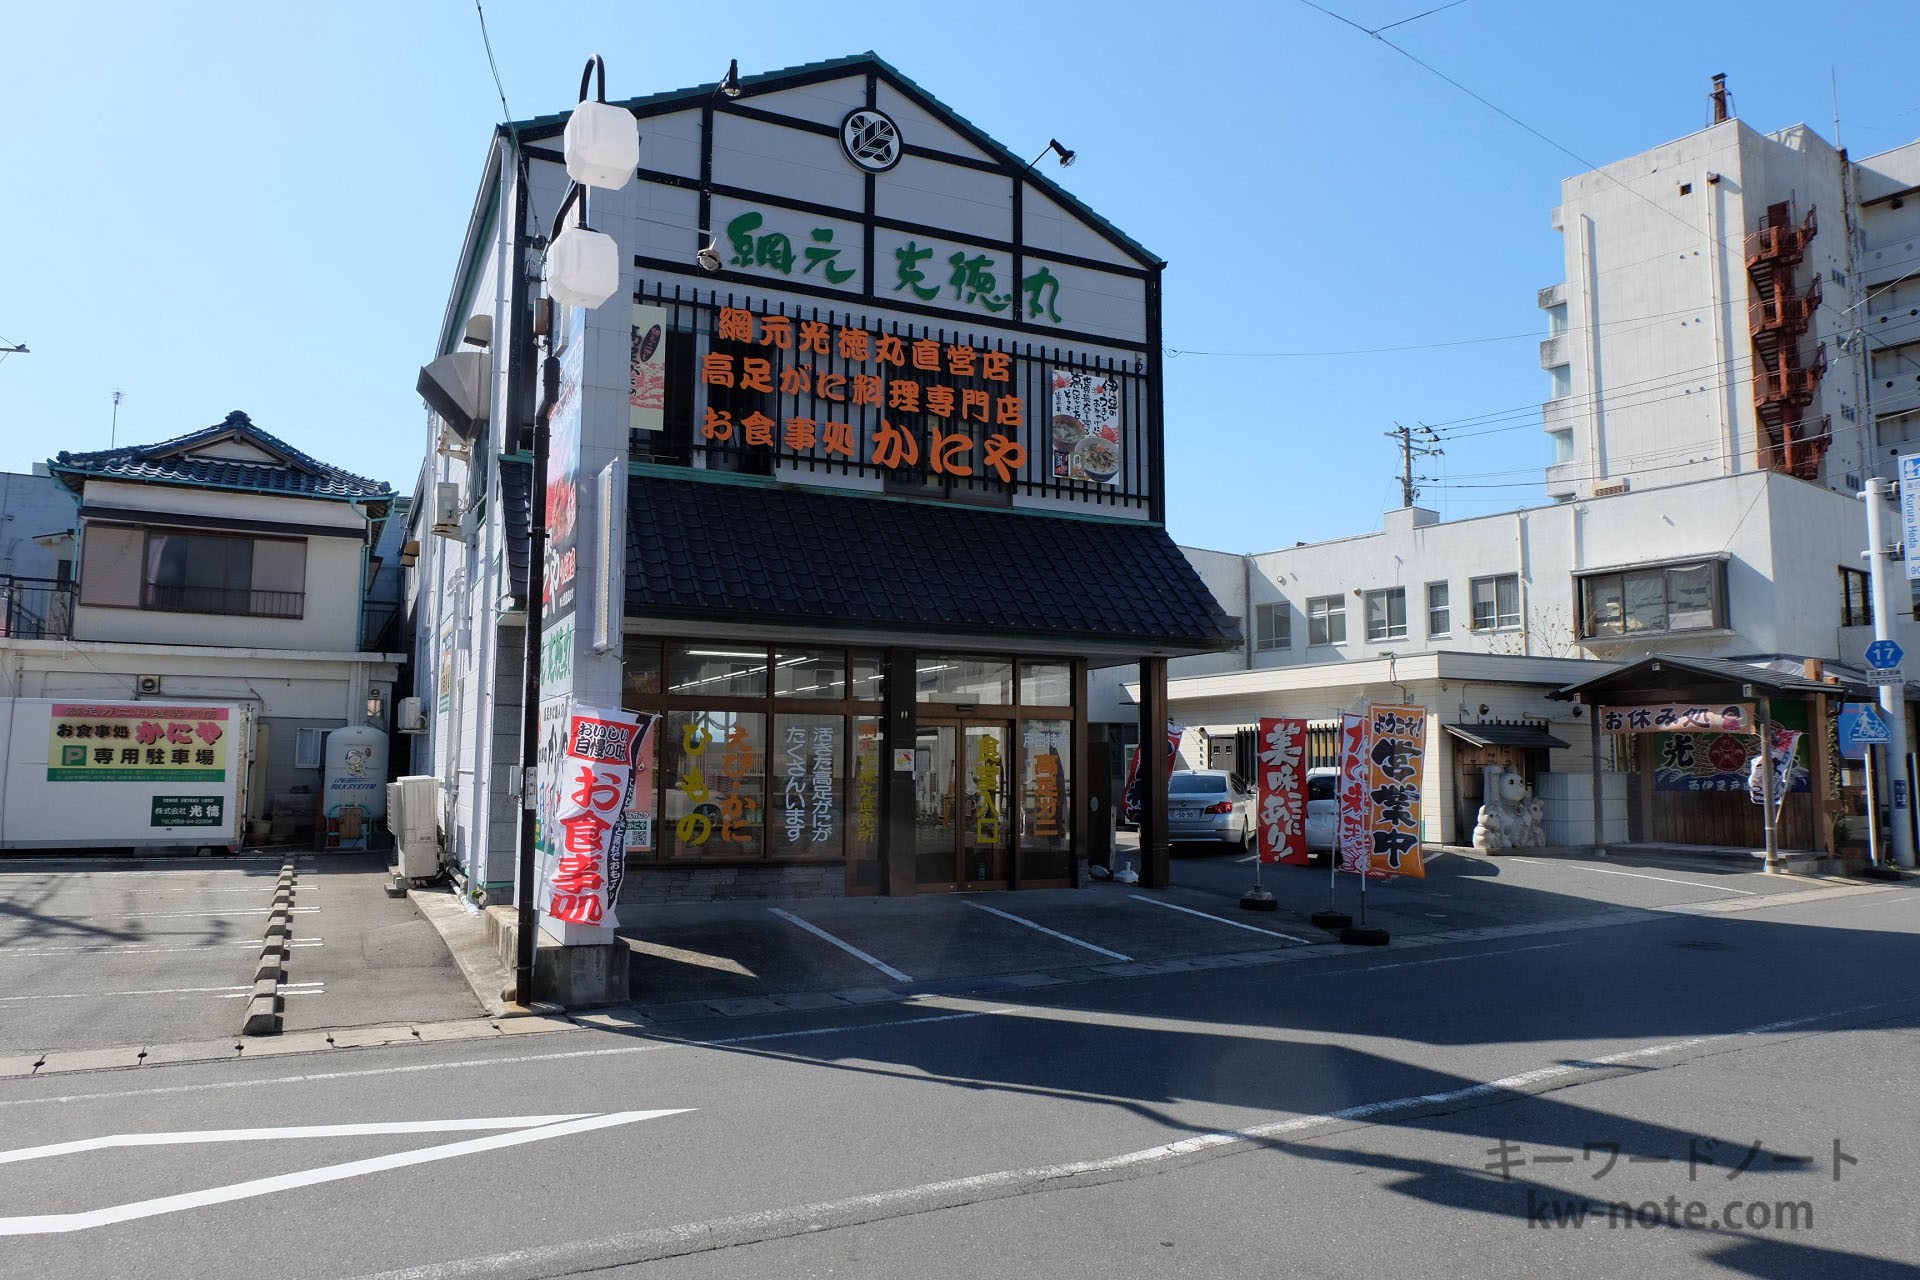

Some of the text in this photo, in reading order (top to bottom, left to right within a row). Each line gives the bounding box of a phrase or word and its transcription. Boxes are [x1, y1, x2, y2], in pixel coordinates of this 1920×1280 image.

[727, 211, 1062, 324] 網元 光徳丸
[718, 306, 1011, 383] 網元光徳丸直営店
[701, 352, 1025, 427] 高足がに料理専門店
[701, 407, 1028, 484] お食事処 かにや
[1906, 493, 1916, 524] Kurura
[1908, 525, 1918, 549] Heda
[1873, 648, 1895, 661] 17
[66, 706, 218, 720] 高足ガニ料理専門店
[1605, 707, 1711, 731] お休み処
[57, 721, 223, 746] お食事処 かにや
[575, 736, 627, 762] 自慢の味
[578, 722, 629, 743] おいしい
[93, 748, 215, 766] 専用駐車場
[1664, 734, 1695, 768] 光
[676, 723, 712, 845] ひもの
[784, 726, 807, 843] たくさんいます
[811, 726, 834, 843] 活きた高足がにが
[976, 734, 1001, 844] 食堂入口
[1034, 753, 1059, 836] 高足ガニ
[154, 807, 187, 815] 株式会社
[1371, 738, 1423, 868] 営業中
